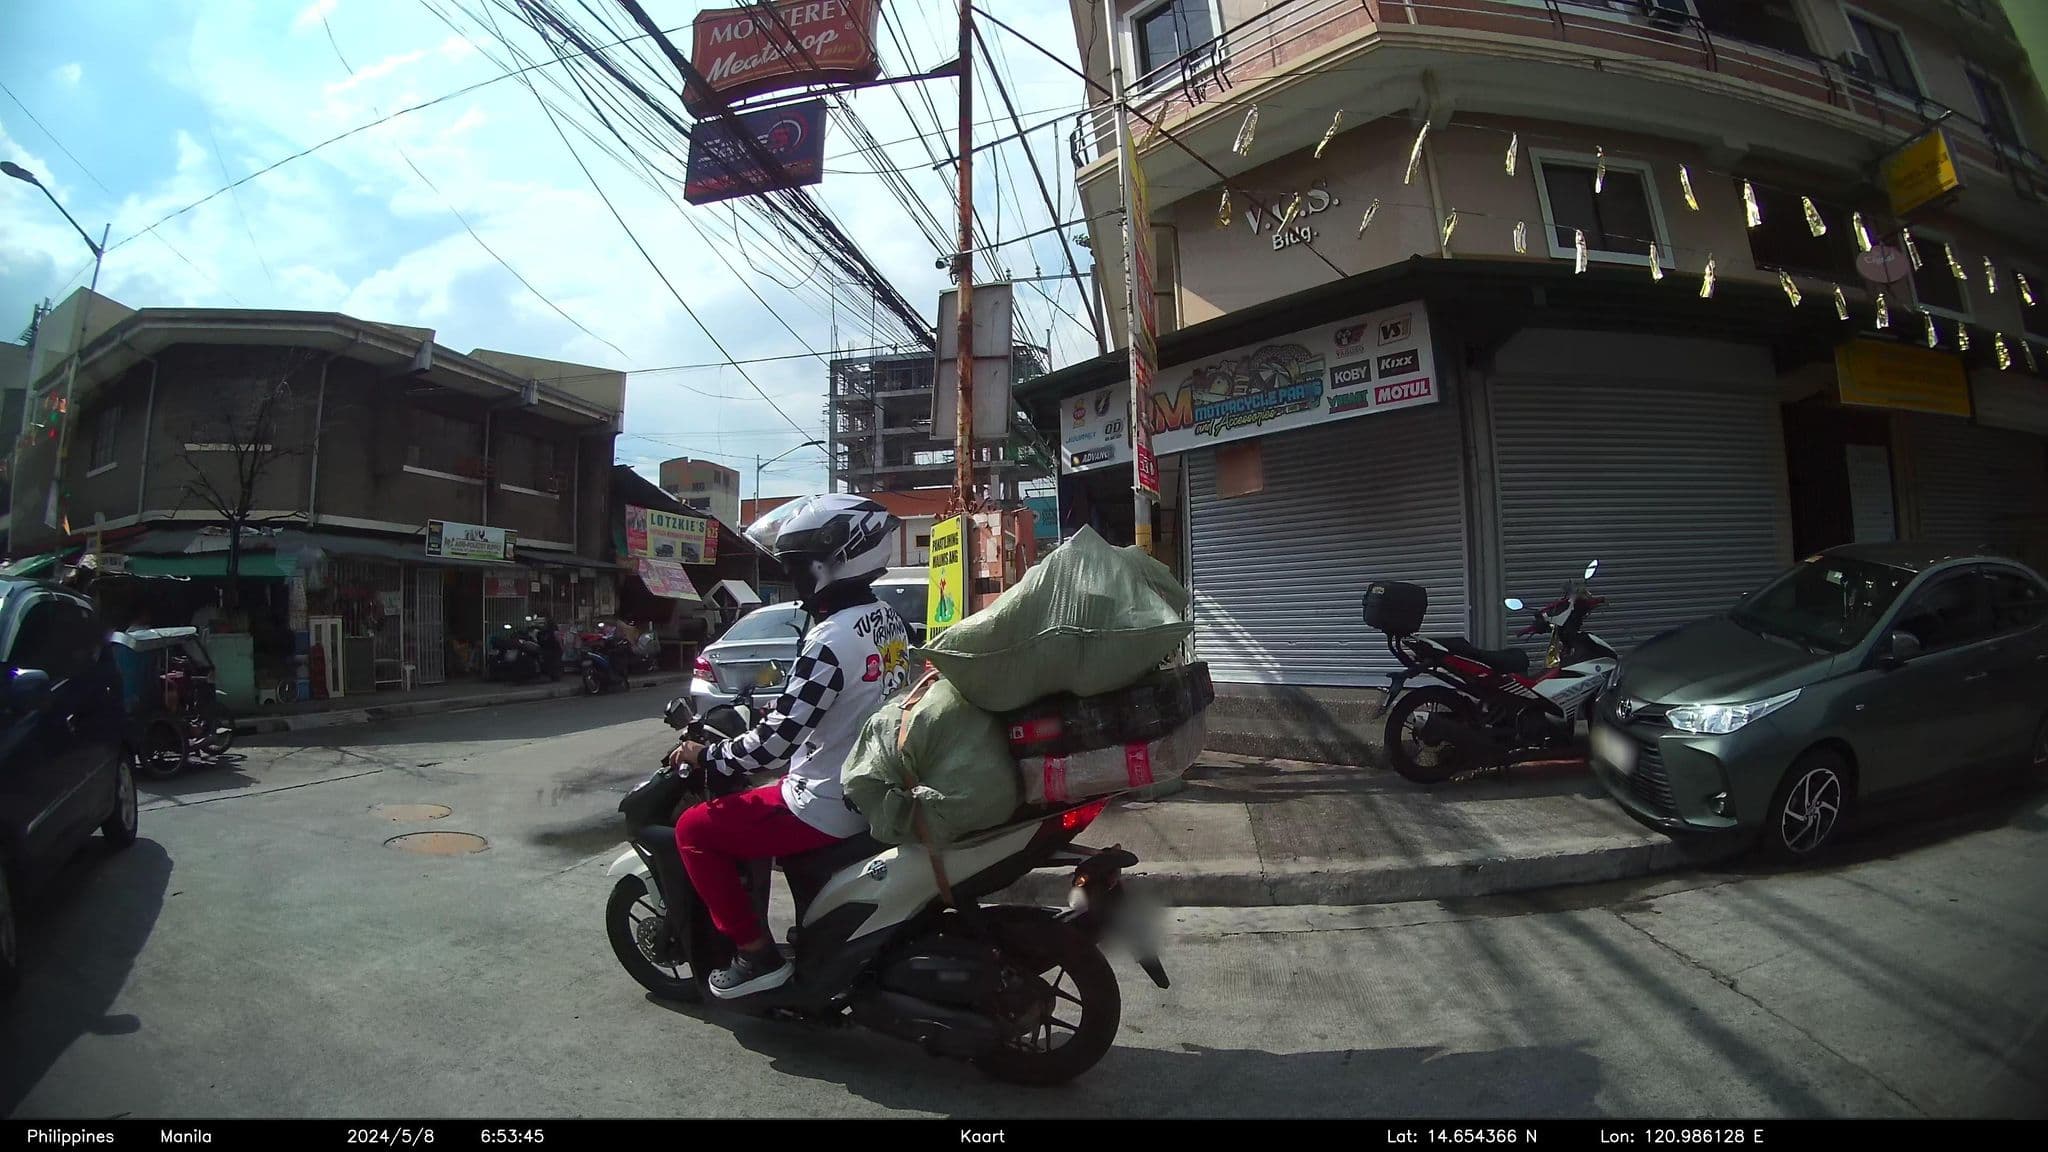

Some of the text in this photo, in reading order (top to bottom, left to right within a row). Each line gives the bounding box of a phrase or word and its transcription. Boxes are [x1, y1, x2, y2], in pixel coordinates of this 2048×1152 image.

[709, 0, 852, 46] MONTEREY
[706, 28, 839, 82] Meatshop
[1334, 366, 1368, 385] KOBY
[1377, 381, 1428, 403] MOTUL
[1195, 389, 1278, 422] MOTORCYCLE
[1195, 420, 1215, 437] and
[650, 513, 706, 534] LOTZKIE'S
[853, 609, 883, 637] JUST
